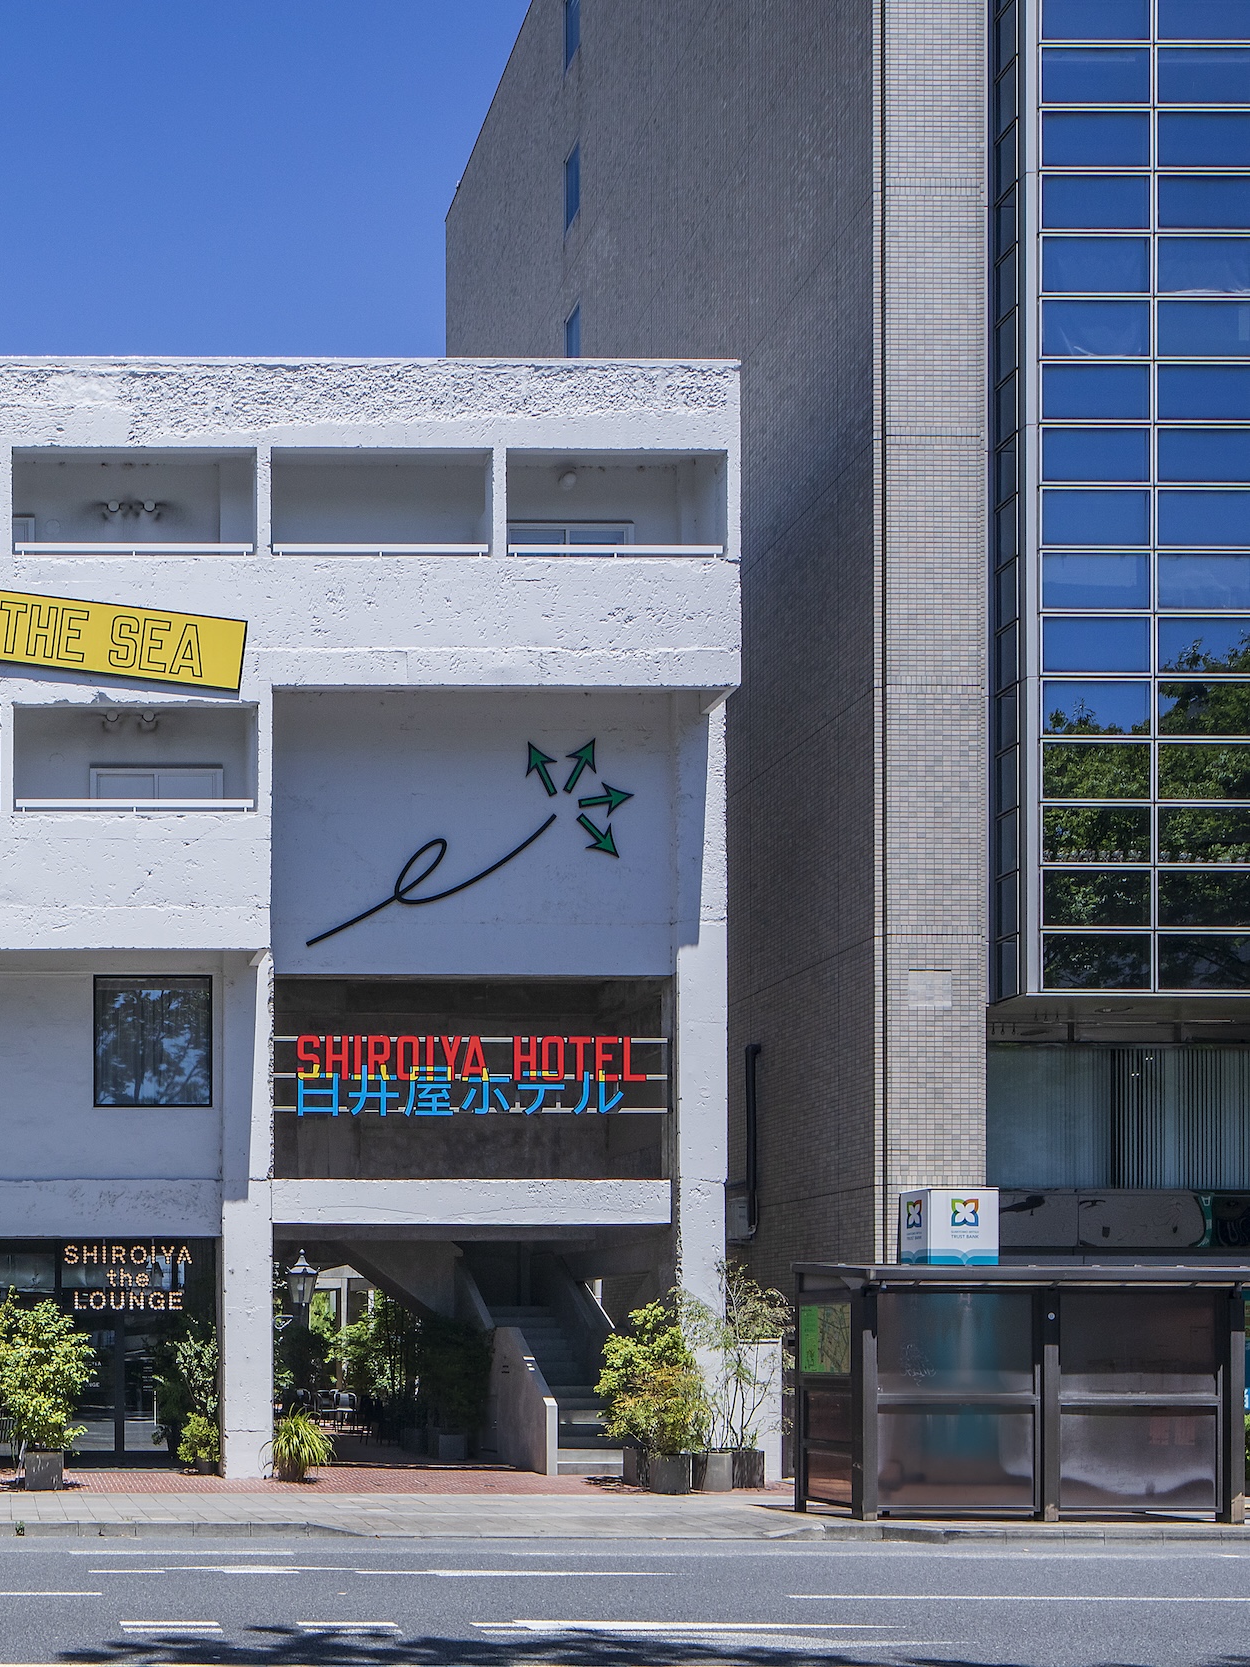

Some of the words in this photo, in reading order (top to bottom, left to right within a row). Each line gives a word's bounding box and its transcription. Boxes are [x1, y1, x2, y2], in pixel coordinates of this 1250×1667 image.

[0, 600, 90, 663] THE
[108, 615, 203, 678] SEA
[297, 1035, 489, 1081] SHIROIYA
[513, 1035, 647, 1082] HOTEL
[297, 1064, 624, 1116] 白井屋ホテル
[64, 1245, 193, 1264] SHIROIYA
[106, 1268, 149, 1287] the
[74, 1291, 183, 1310] LOUNGE
